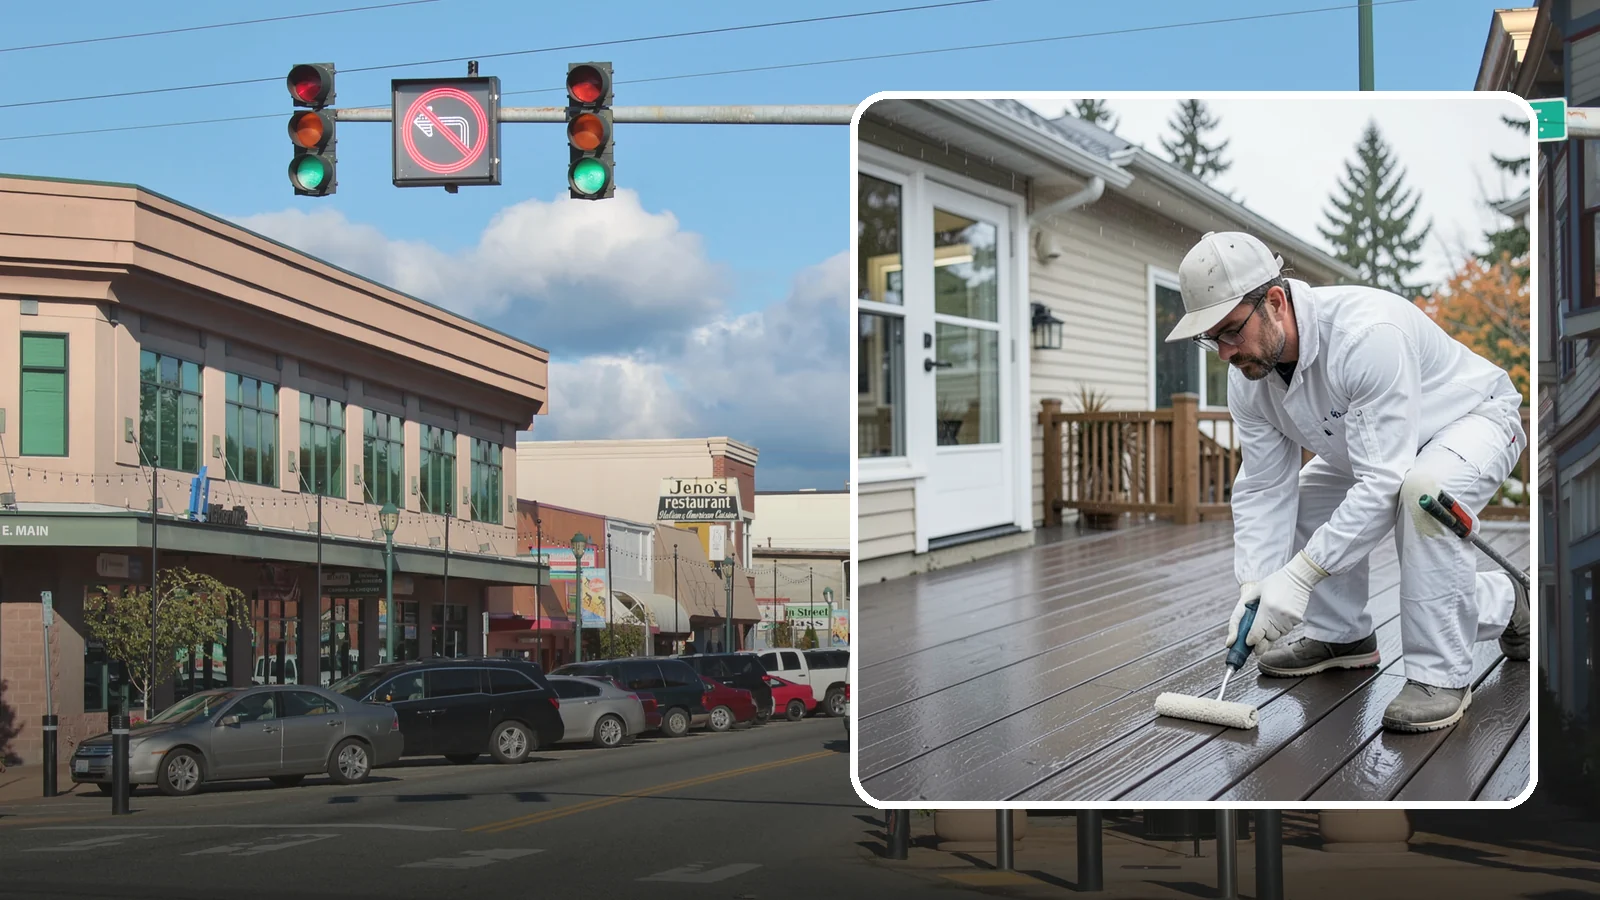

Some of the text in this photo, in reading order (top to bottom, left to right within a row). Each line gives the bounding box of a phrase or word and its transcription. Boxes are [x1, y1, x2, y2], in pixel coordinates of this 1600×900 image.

[670, 480, 728, 494] Jeno's
[665, 496, 731, 508] restaurant
[658, 510, 682, 520] Italian
[686, 510, 714, 519] American
[715, 510, 738, 519] Cuisine
[2, 525, 48, 536] E. MAIN
[798, 608, 828, 616] Street
